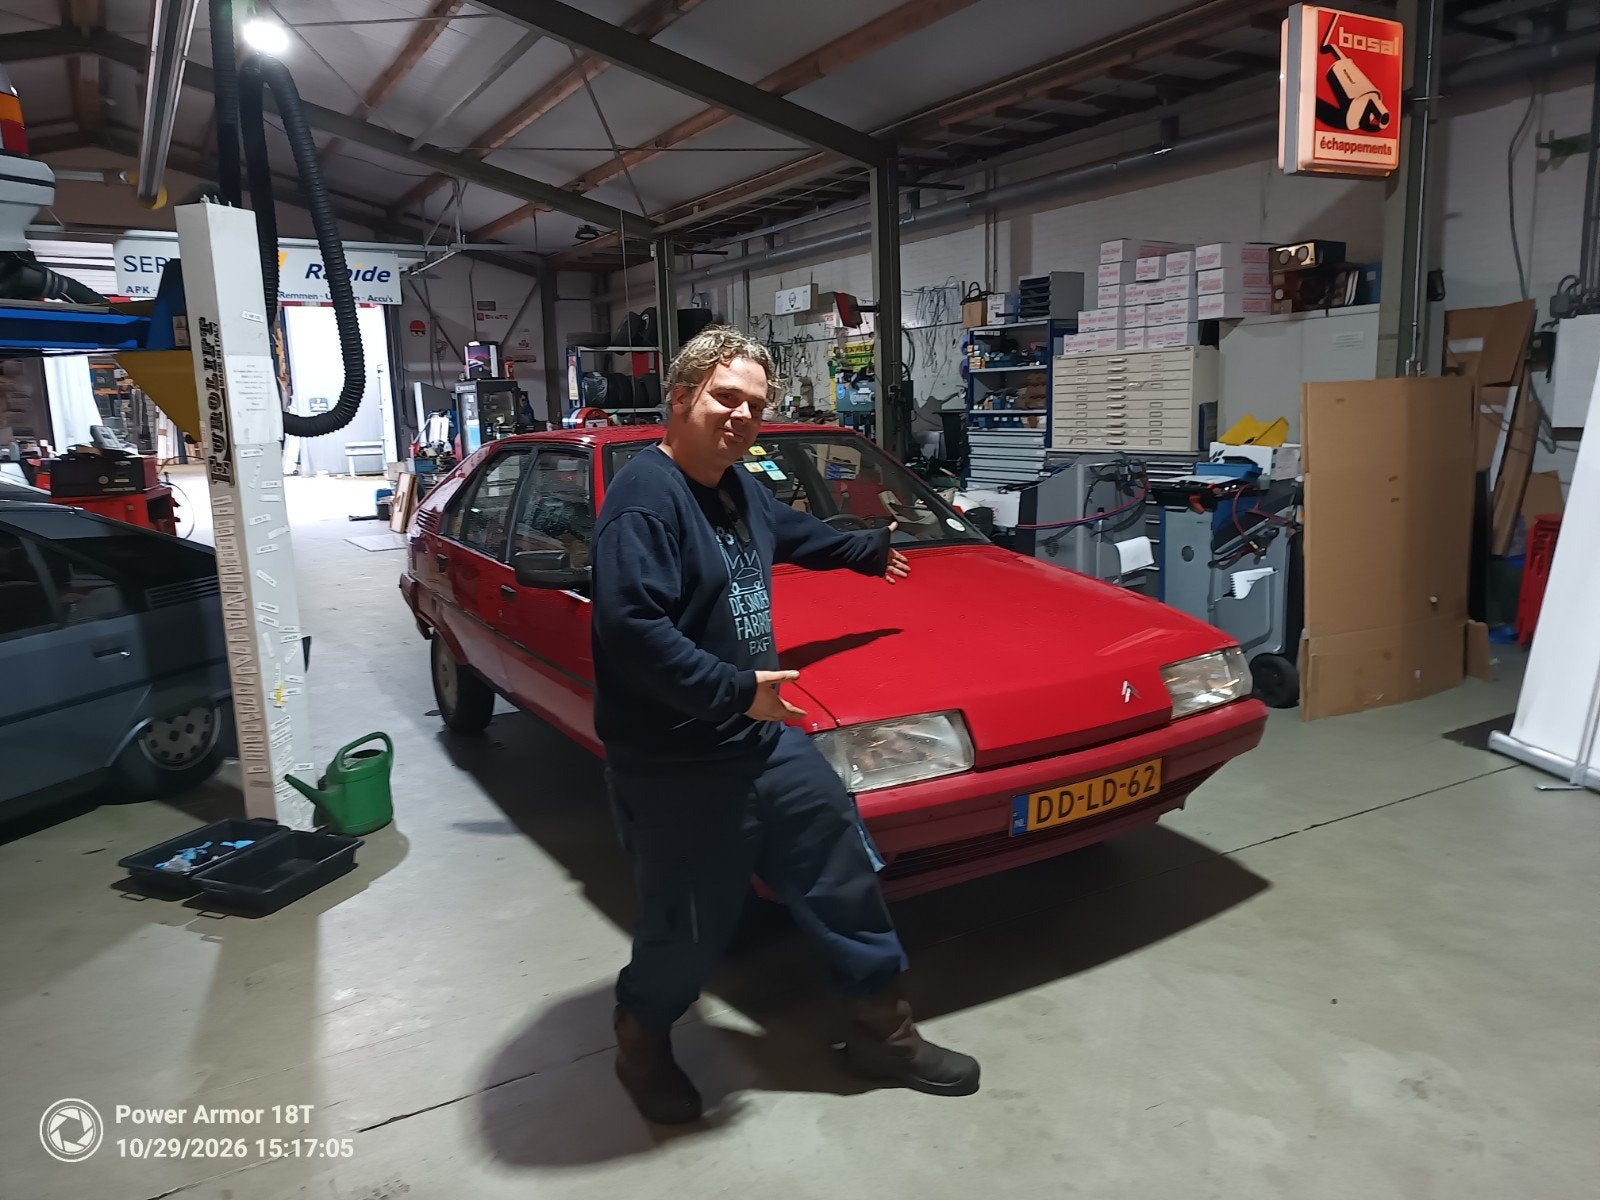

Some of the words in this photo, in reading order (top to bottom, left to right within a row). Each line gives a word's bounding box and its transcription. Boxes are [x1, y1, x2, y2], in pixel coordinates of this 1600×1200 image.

[1338, 26, 1399, 56] bosal
[1320, 136, 1392, 155] échappements
[305, 263, 391, 283] Ride
[125, 285, 150, 294] APK
[212, 322, 221, 348] ITALY
[217, 361, 225, 388] MADE
[728, 595, 748, 617] DE
[1035, 765, 1156, 824] DD-LD-62
